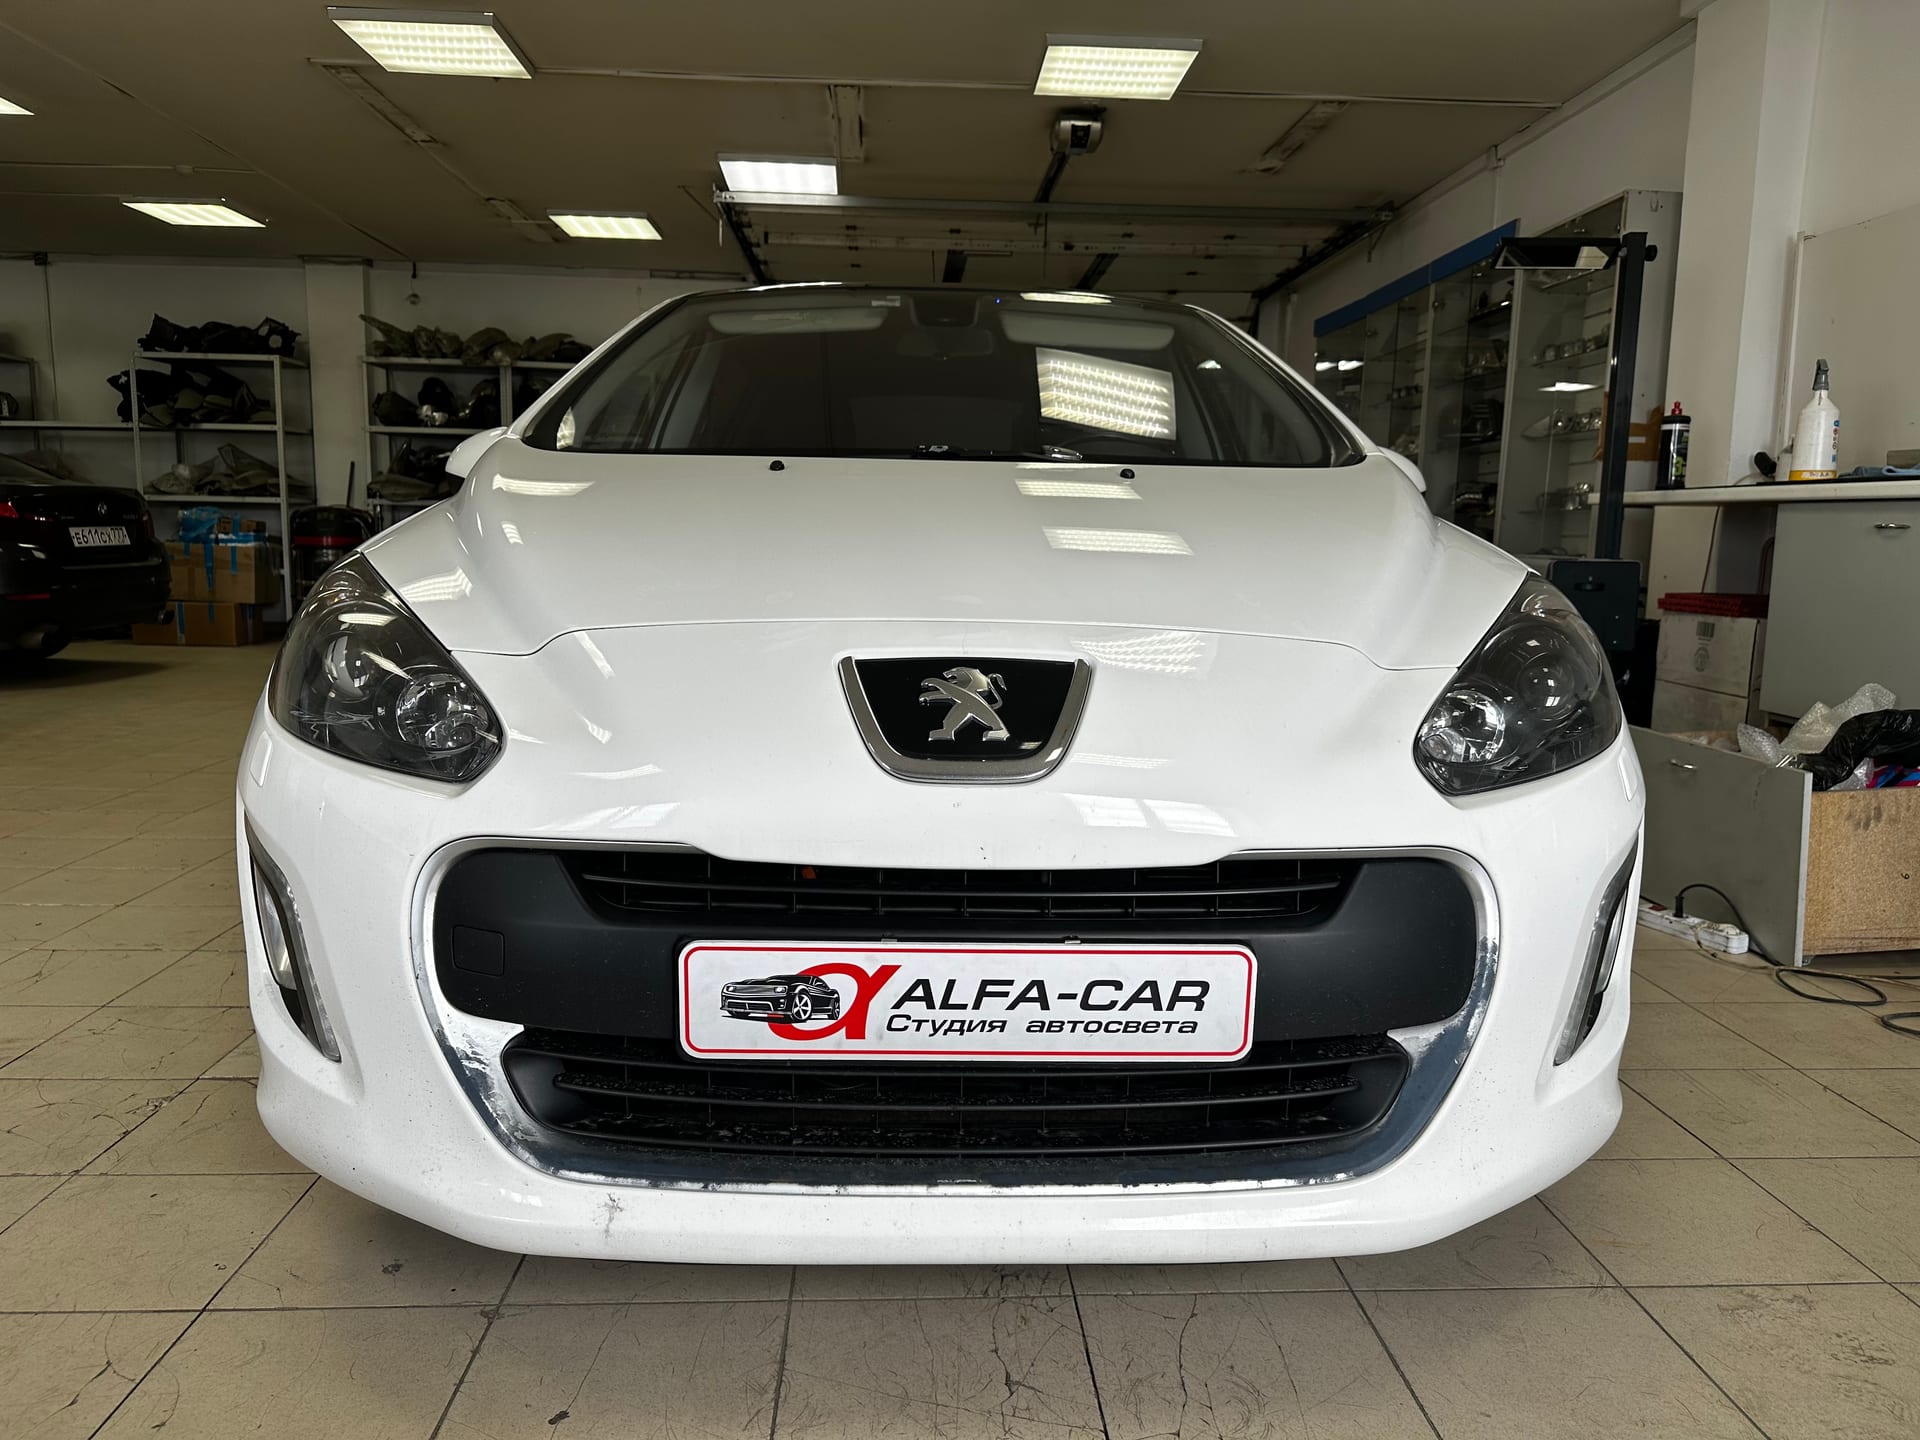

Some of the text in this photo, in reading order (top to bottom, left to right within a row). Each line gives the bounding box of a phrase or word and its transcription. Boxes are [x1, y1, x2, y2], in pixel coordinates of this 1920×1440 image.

[890, 978, 1210, 1013] ALFA-CAR
[886, 1013, 1198, 1037] Студия автосвета
